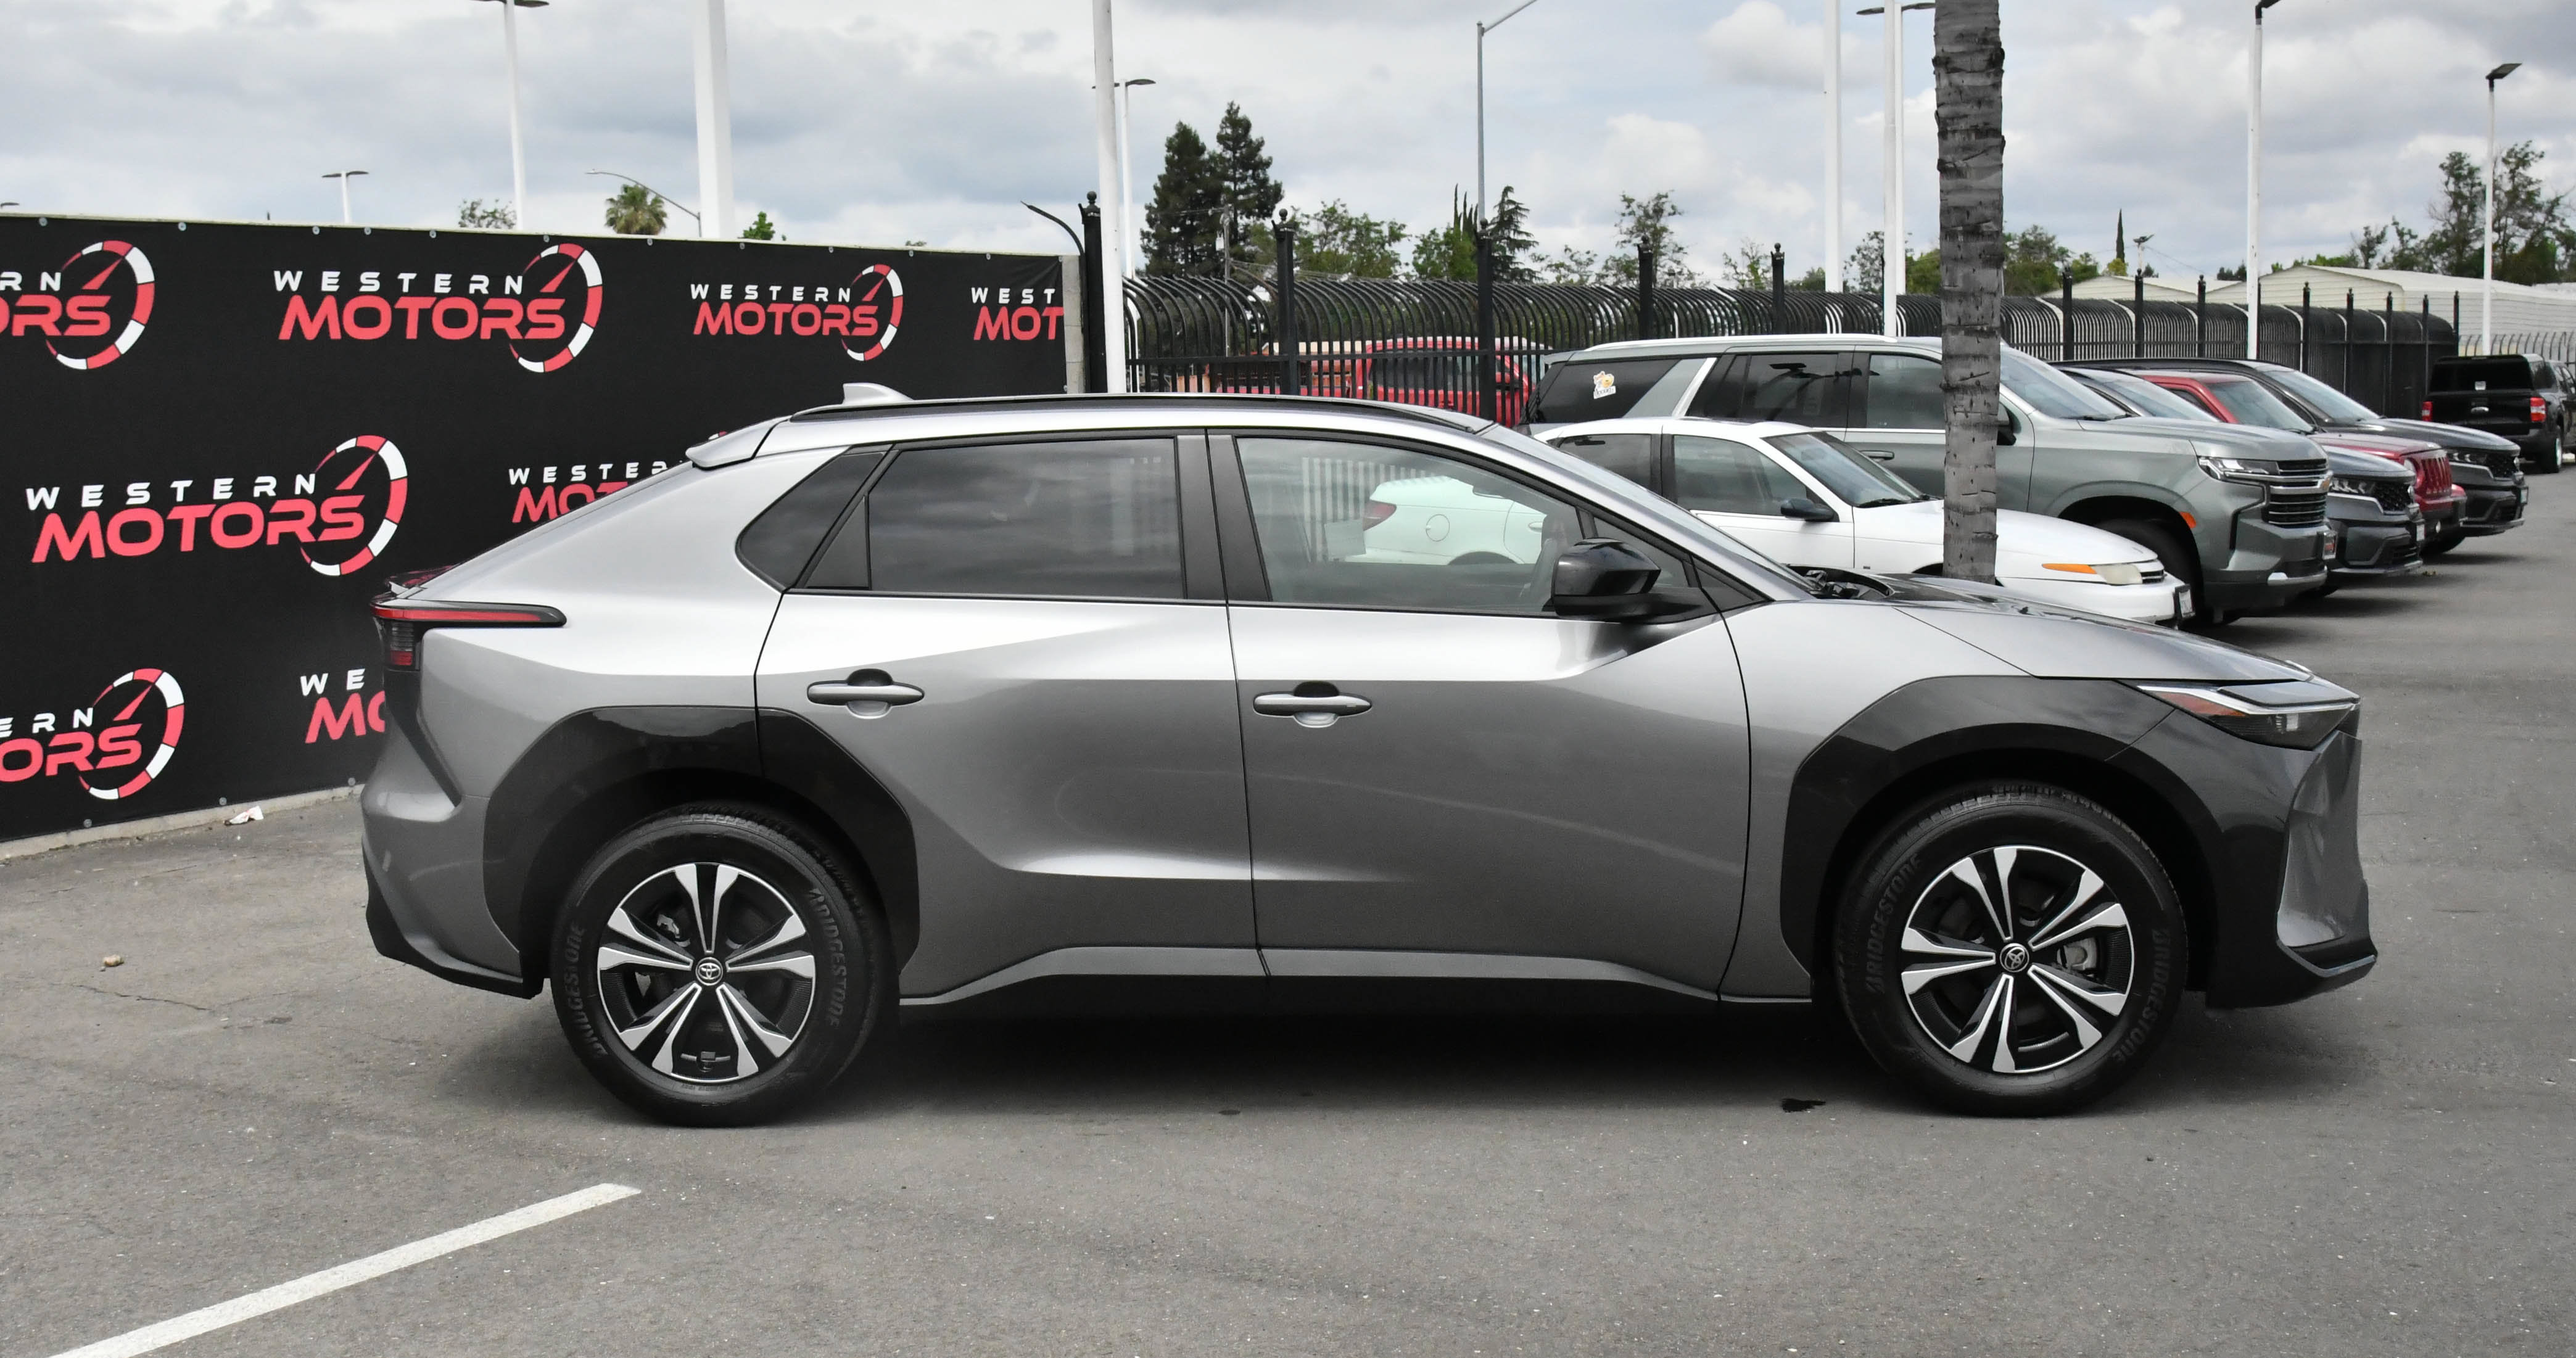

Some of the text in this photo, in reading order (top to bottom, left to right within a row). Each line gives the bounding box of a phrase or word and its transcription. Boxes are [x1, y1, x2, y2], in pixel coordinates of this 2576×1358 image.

[273, 270, 523, 295] WESTERN
[690, 284, 851, 303] WESTERN
[971, 287, 1055, 304] WEST
[0, 294, 112, 336] RS
[278, 294, 566, 340] MOTORS
[693, 302, 878, 336] MOTORS
[973, 305, 1065, 340] MOT
[25, 473, 316, 511] WESTERN
[31, 495, 365, 563] MOTORS
